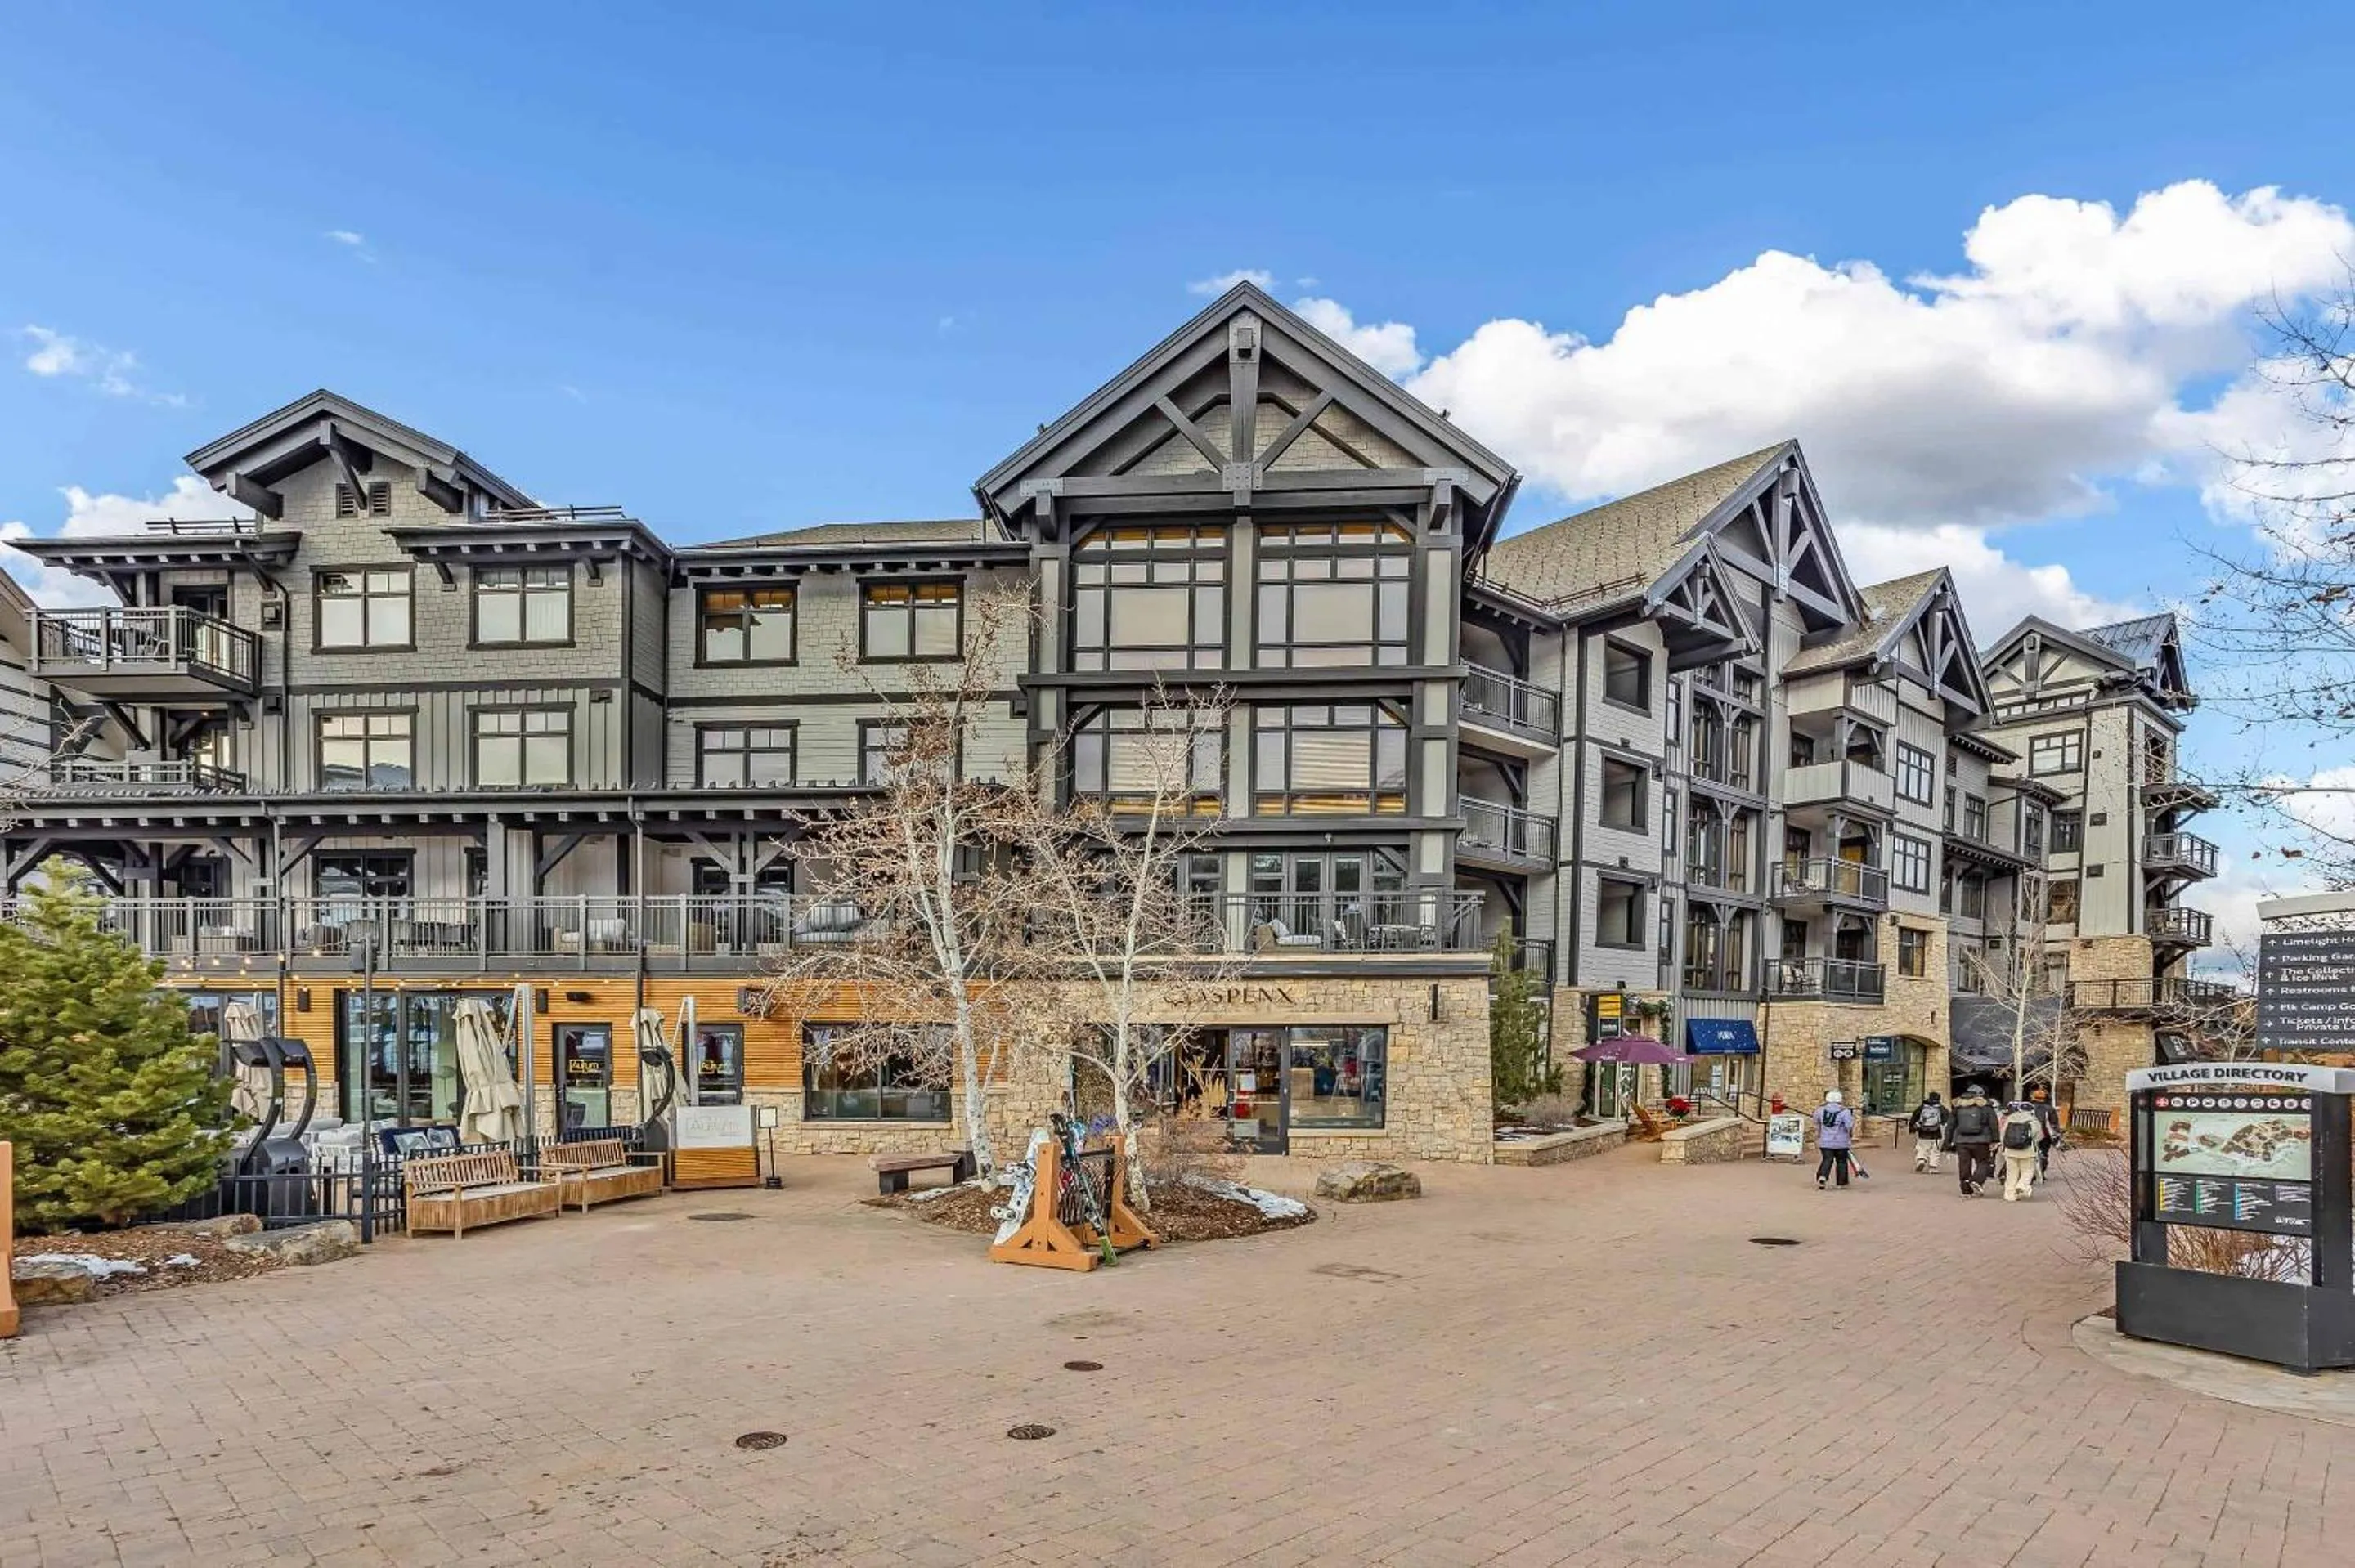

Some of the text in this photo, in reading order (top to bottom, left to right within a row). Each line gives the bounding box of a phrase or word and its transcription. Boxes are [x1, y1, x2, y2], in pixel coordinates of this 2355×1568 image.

[2282, 938, 2339, 947] Limelight
[2282, 952, 2355, 963] Parking Gar
[2281, 967, 2303, 975] The
[2281, 987, 2348, 995] Restrooms
[2280, 1003, 2298, 1011] Elk
[2301, 1002, 2336, 1012] Camp
[2280, 1016, 2322, 1024] Tickets
[2147, 1068, 2309, 1082] VILLAGE DIRECTORY
